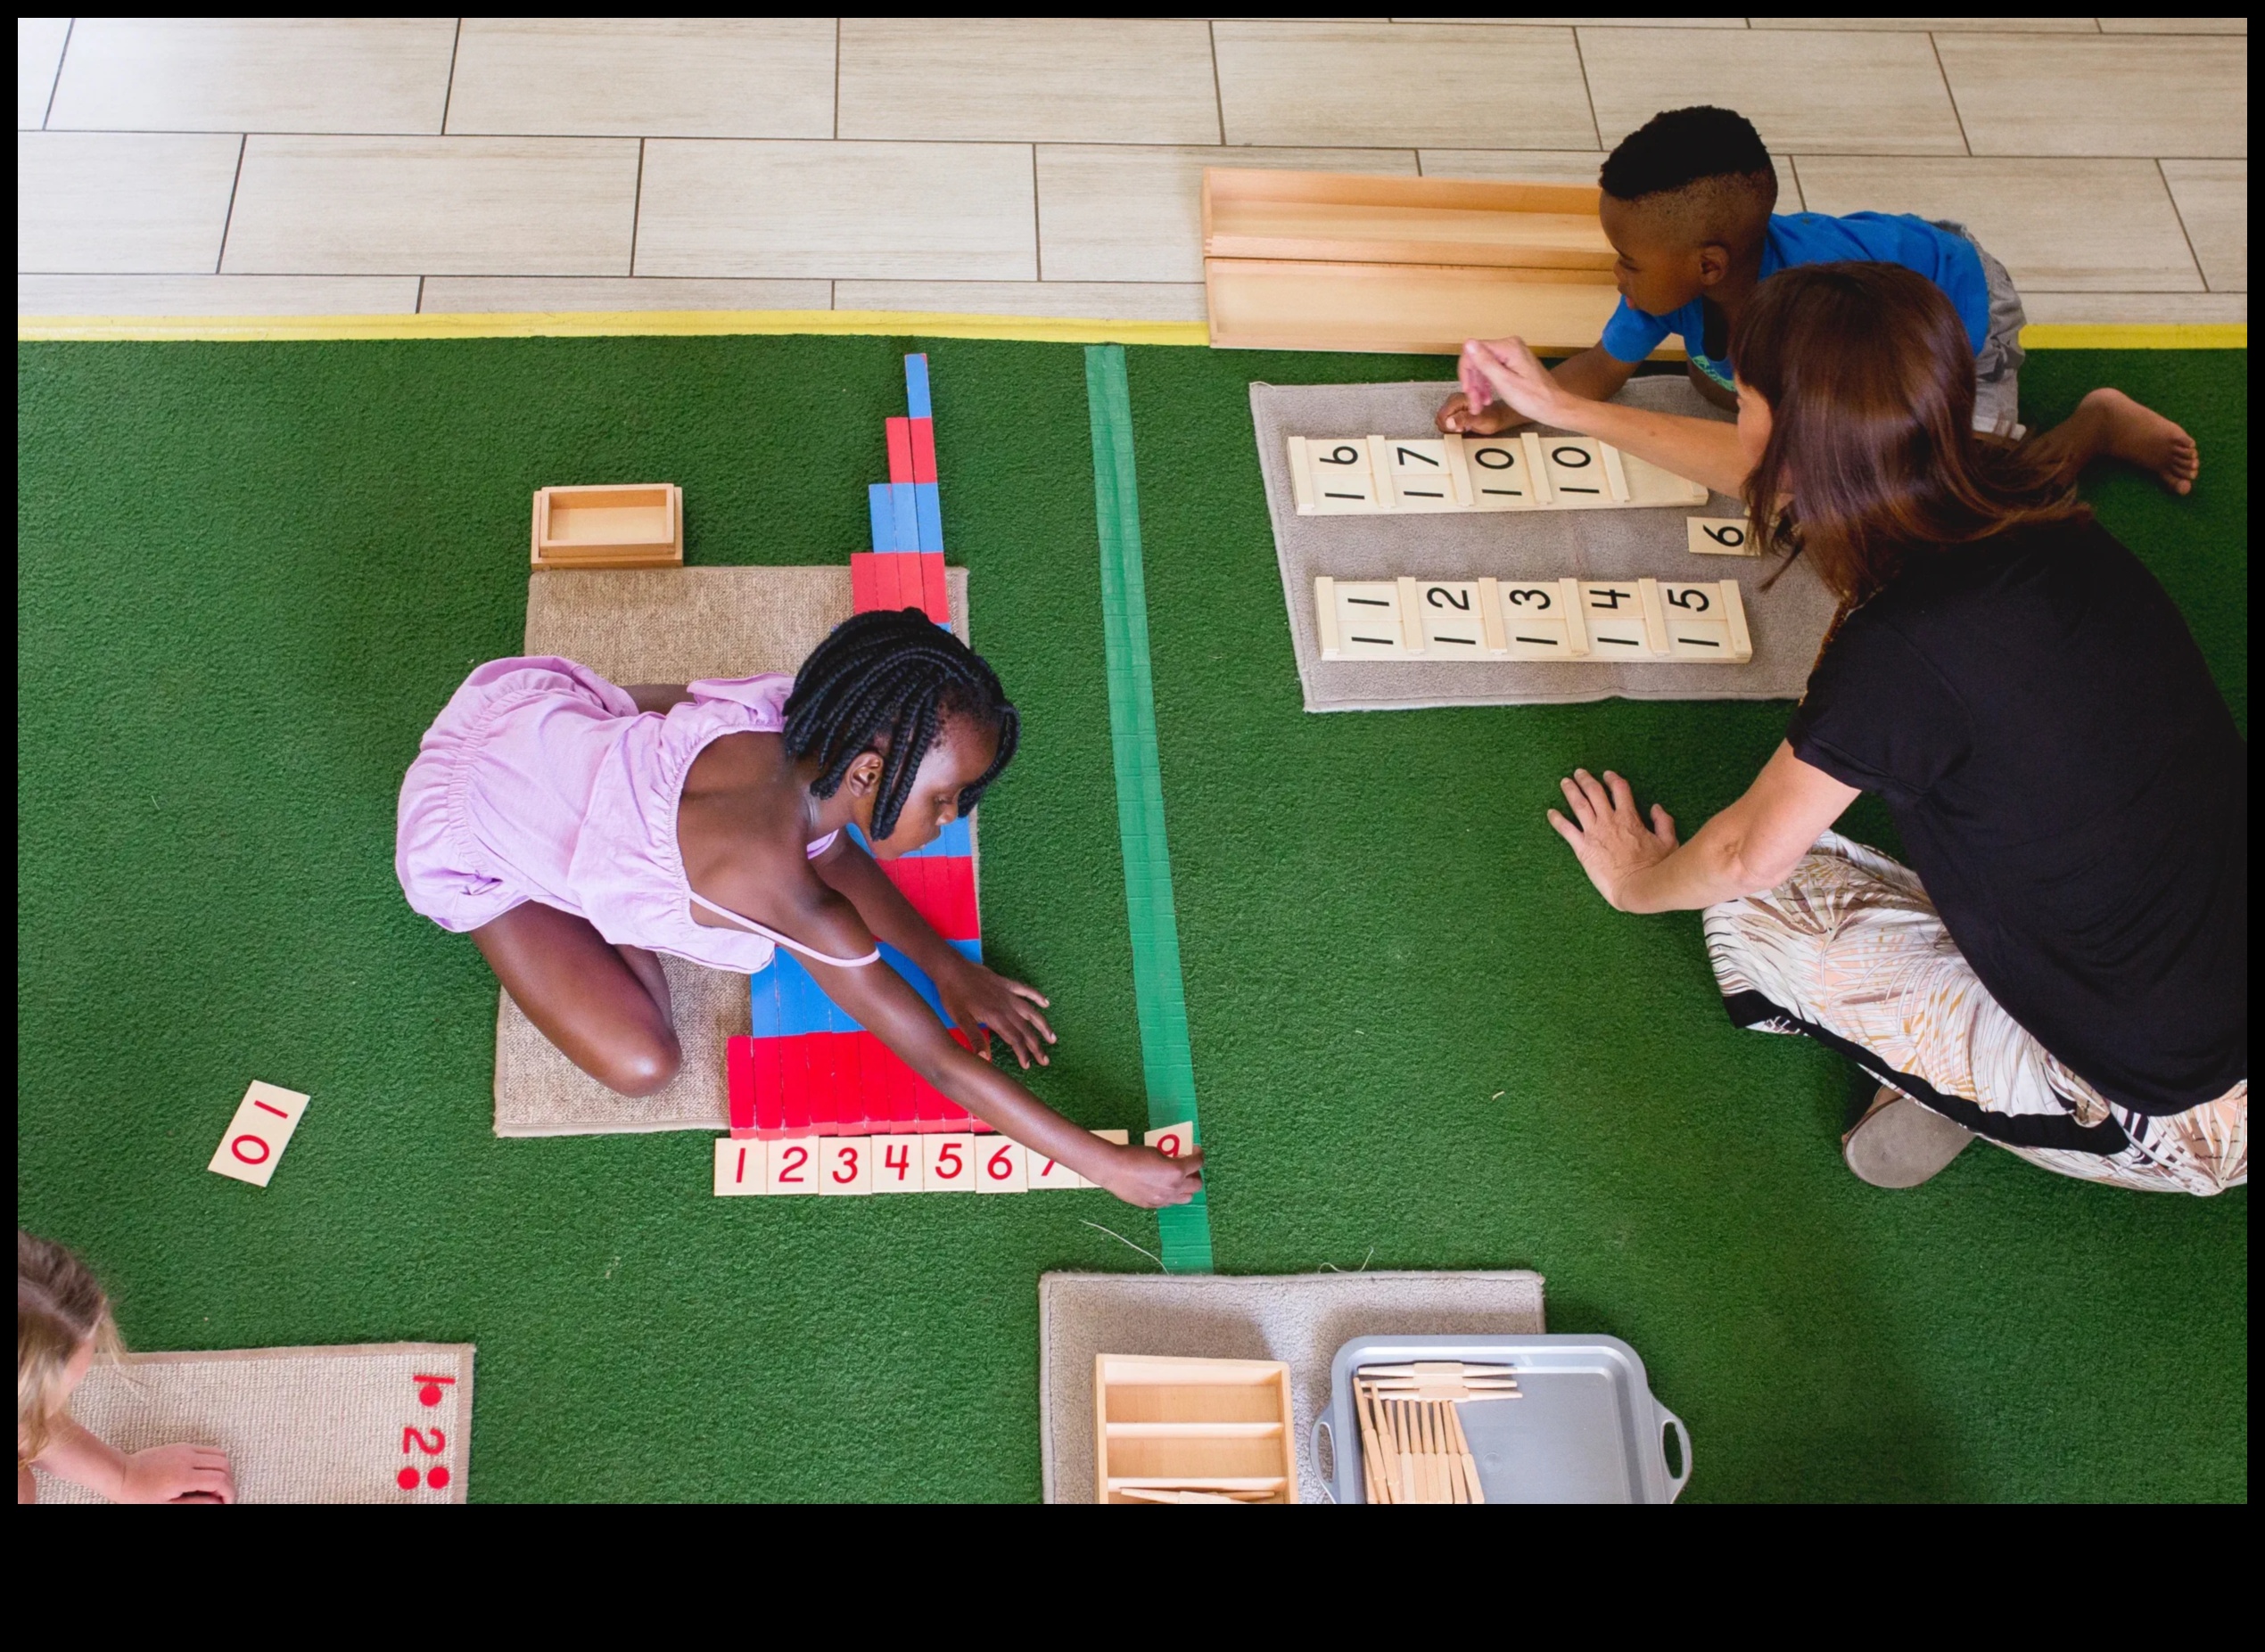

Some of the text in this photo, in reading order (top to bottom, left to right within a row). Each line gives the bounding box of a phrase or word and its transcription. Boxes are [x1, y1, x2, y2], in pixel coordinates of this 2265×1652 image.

[1702, 524, 1745, 547] 6
[735, 1147, 746, 1183] 1
[778, 1146, 809, 1183] 2
[832, 1147, 858, 1184] 3
[885, 1145, 910, 1180] 4
[935, 1142, 963, 1179] 5
[987, 1145, 1013, 1180] 6
[402, 1426, 446, 1456] 2
